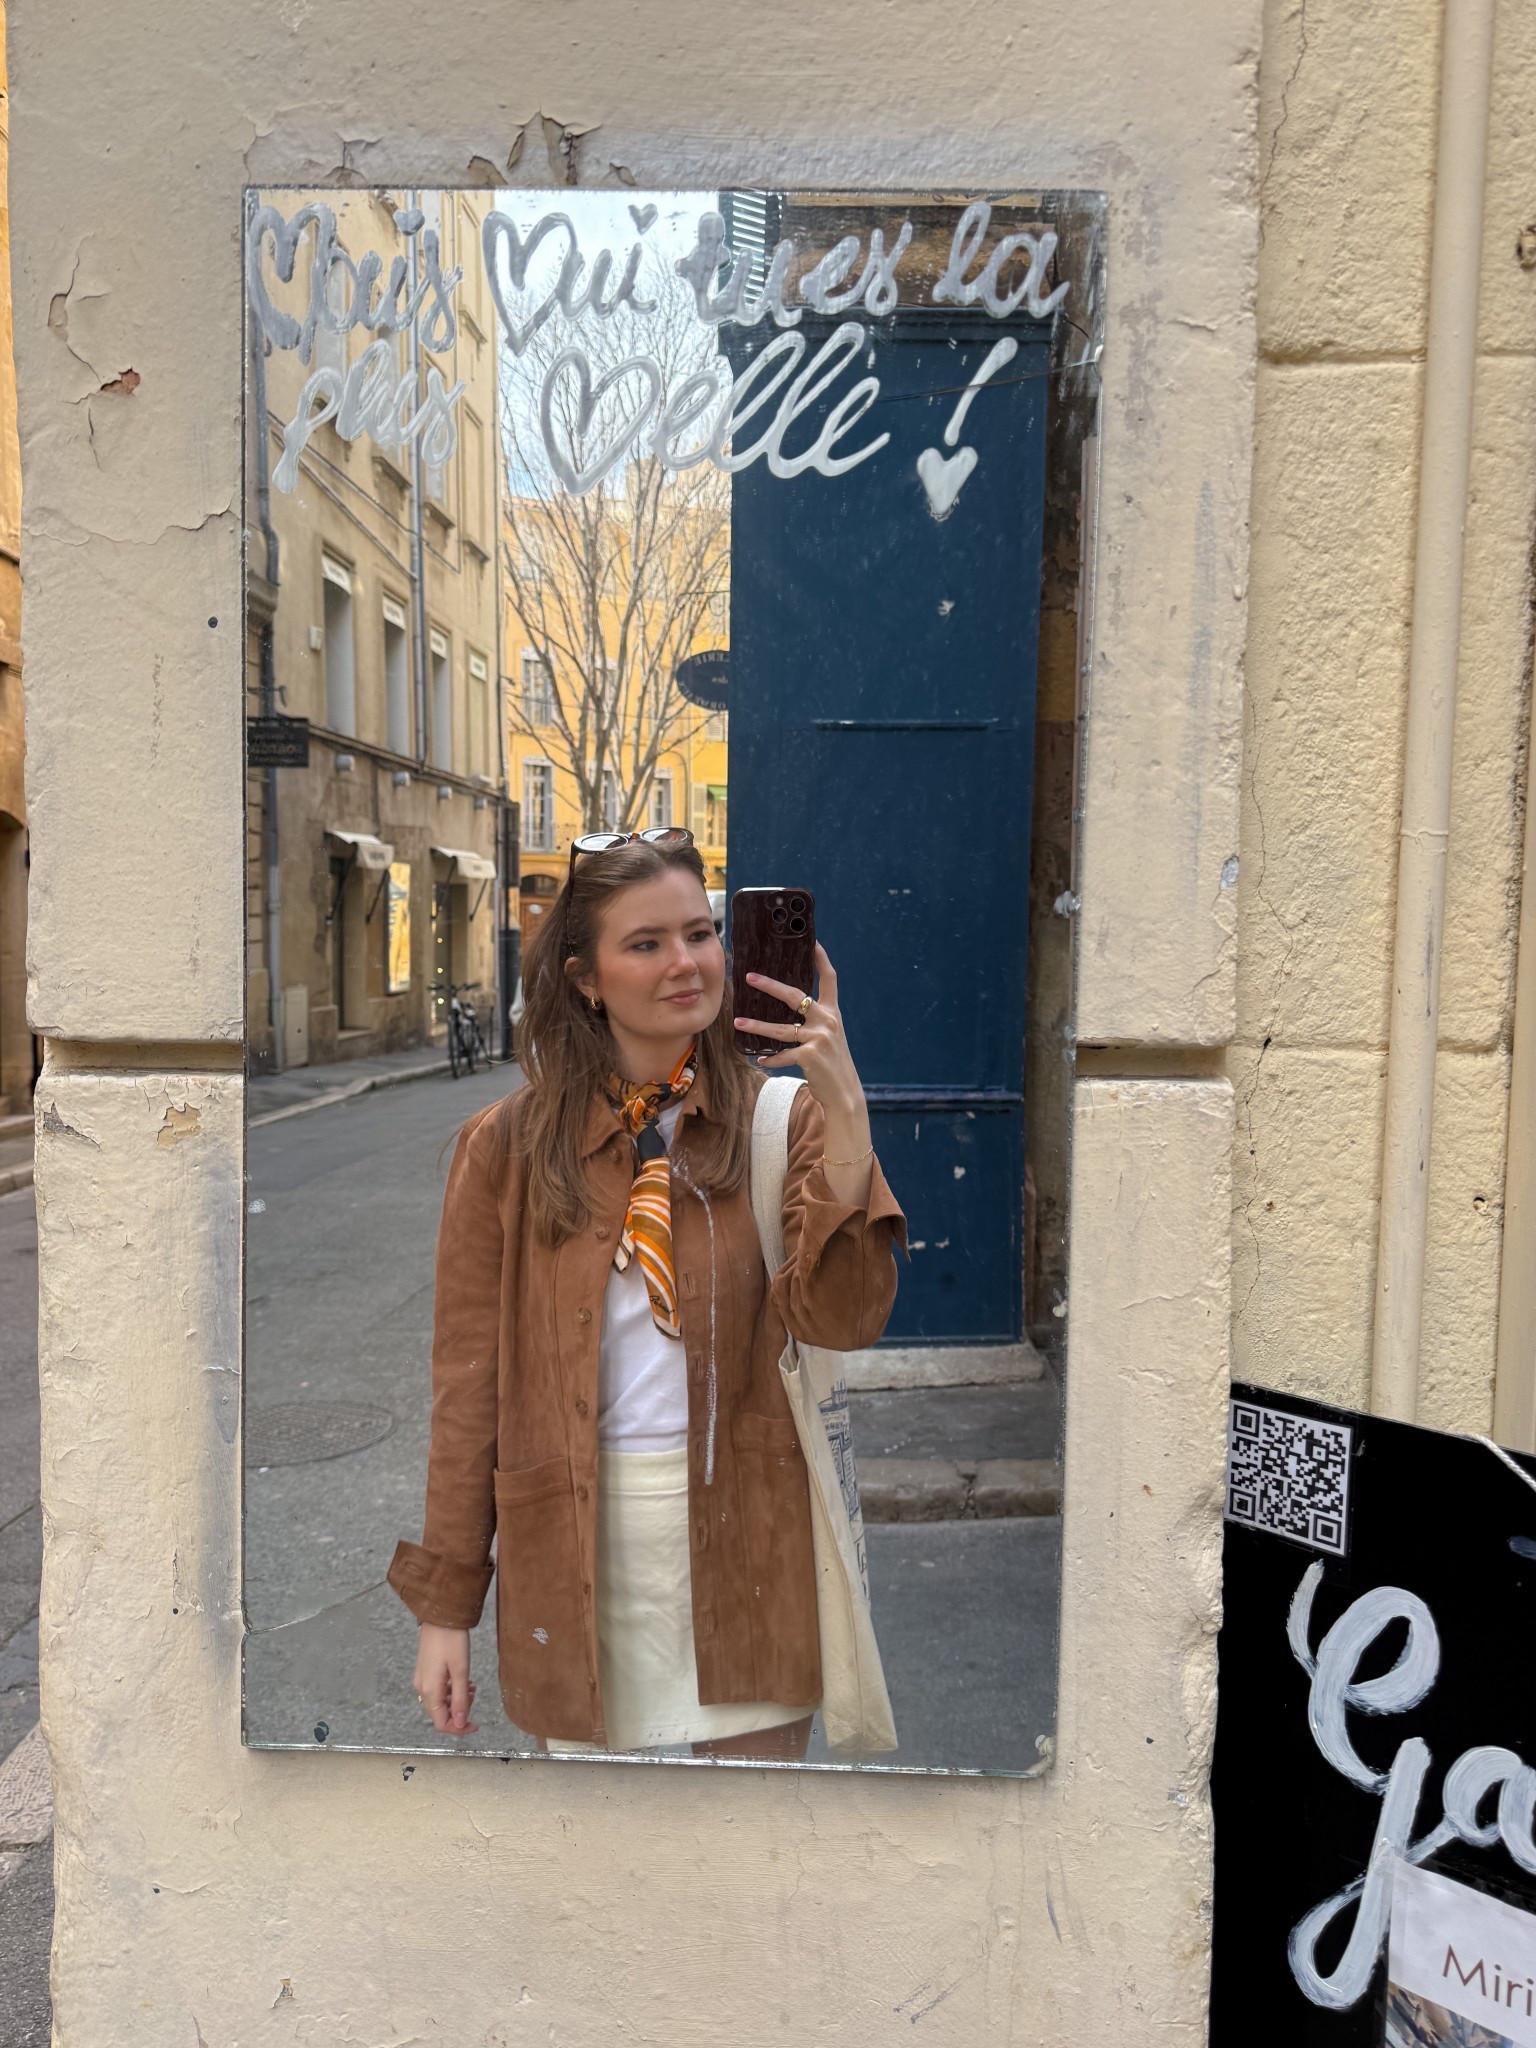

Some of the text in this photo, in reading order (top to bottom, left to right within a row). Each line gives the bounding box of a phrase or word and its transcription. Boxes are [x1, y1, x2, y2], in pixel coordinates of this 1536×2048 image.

[932, 201, 1070, 319] la
[272, 338, 466, 494] plus
[1442, 1943, 1534, 2017] Miri
